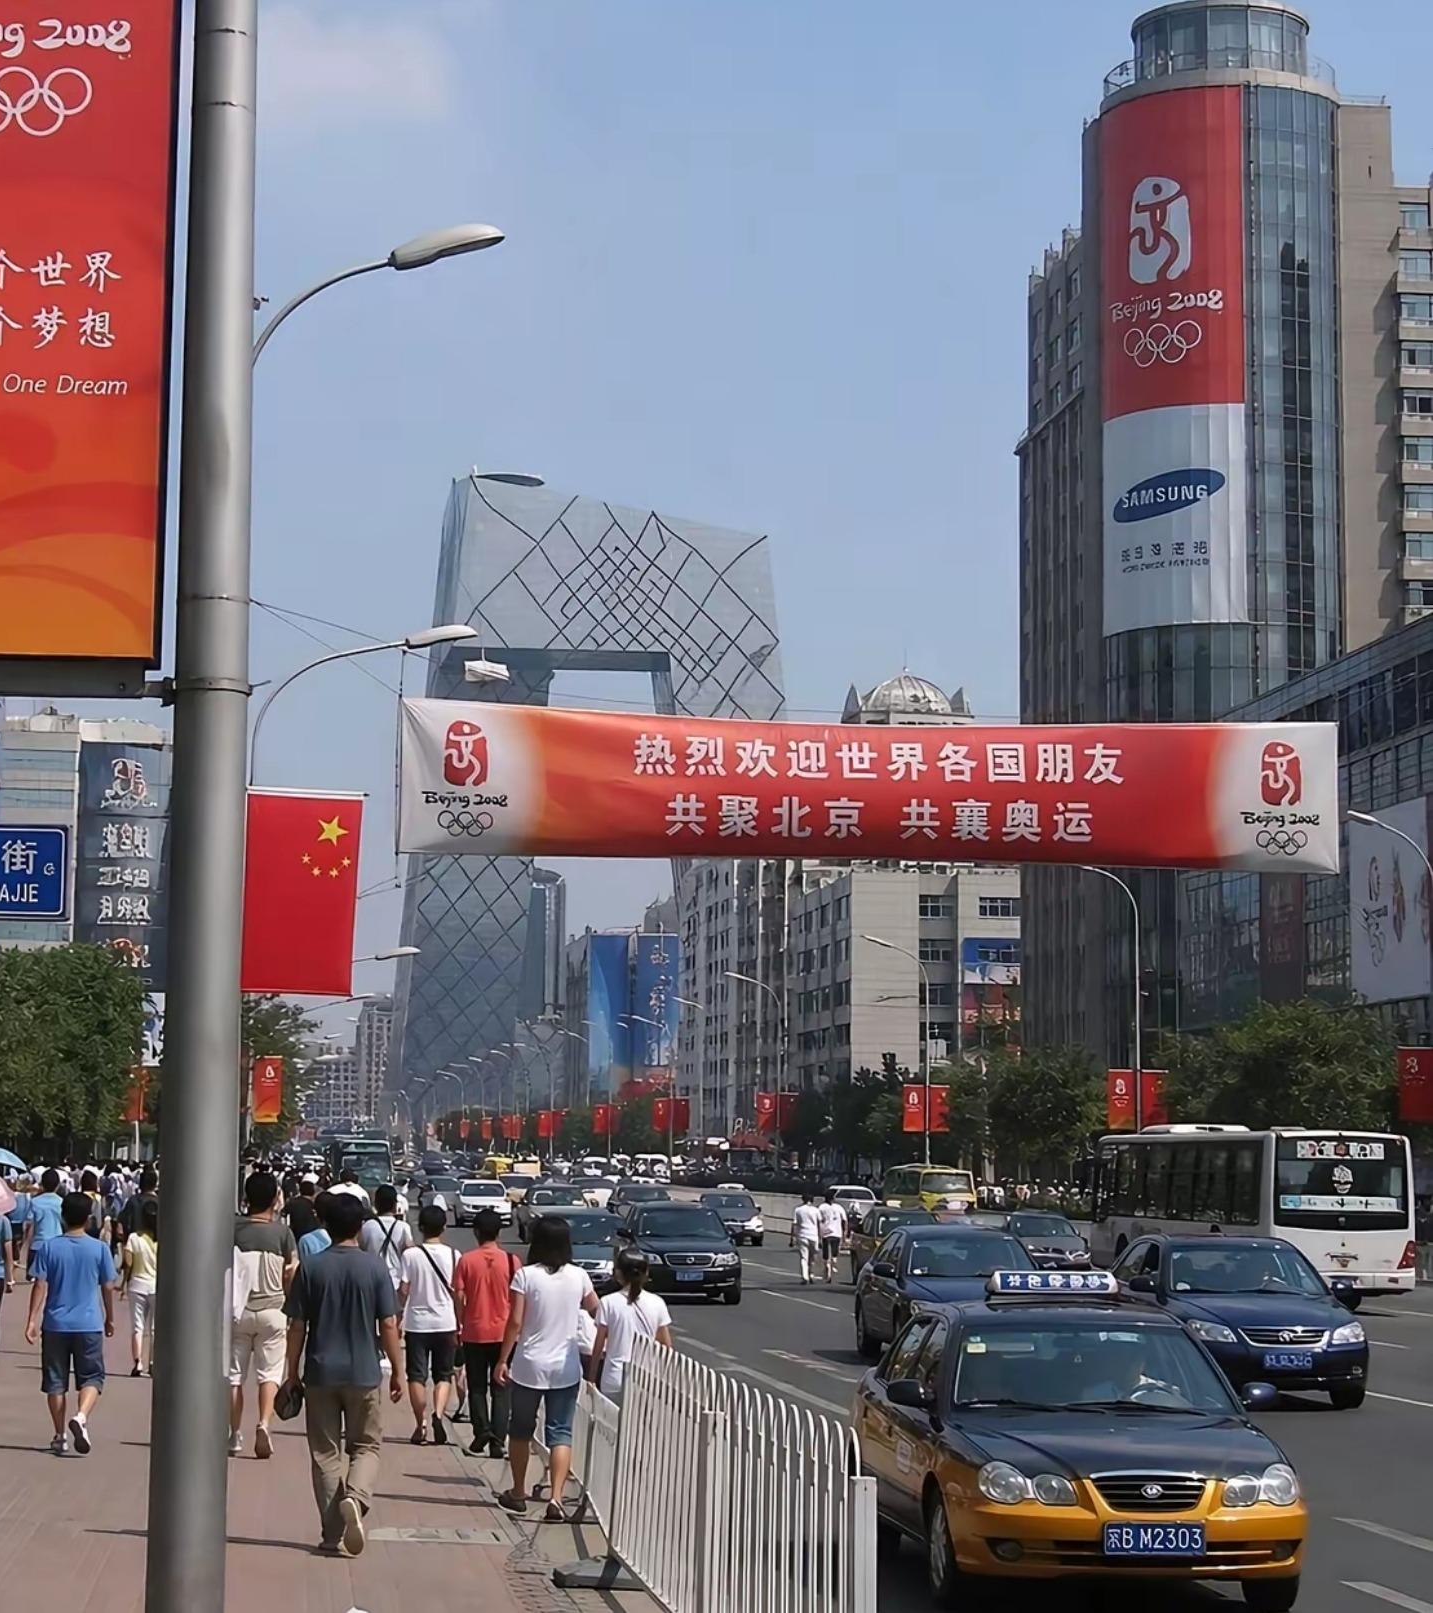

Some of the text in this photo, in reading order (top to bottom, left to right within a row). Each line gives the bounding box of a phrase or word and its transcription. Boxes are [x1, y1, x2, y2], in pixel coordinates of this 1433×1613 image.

[32, 18, 132, 53] 2008
[1109, 294, 1162, 323] Beijing
[2, 374, 48, 394] One
[56, 374, 128, 396] Dream
[1121, 484, 1209, 508] SAMSUNG
[633, 732, 1125, 785] 热烈欢迎世界各国朋友
[664, 793, 1093, 843] 共聚北京 共襄奥运
[1139, 1528, 1202, 1549] M2303
